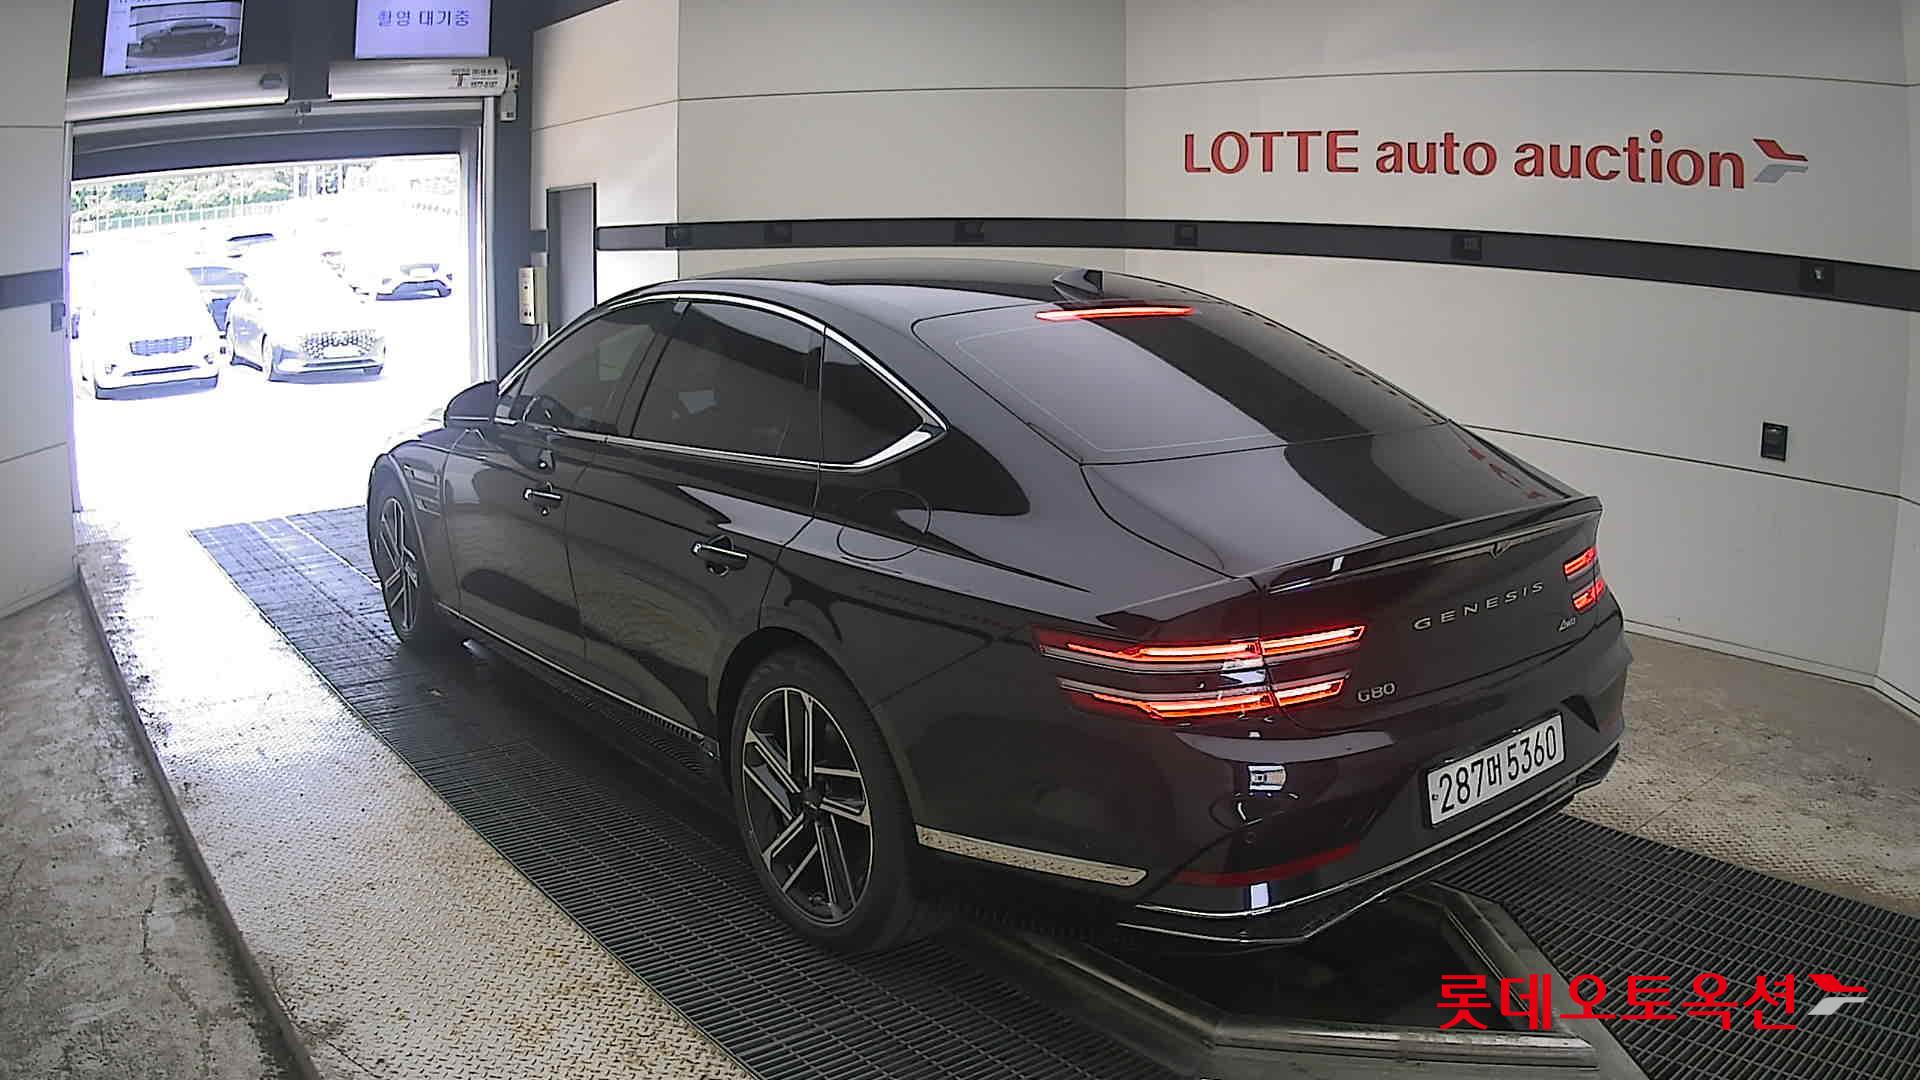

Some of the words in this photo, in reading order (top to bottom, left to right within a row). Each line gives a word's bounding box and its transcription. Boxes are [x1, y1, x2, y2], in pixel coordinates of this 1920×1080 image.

[419, 9, 469, 26] 대기중
[1184, 129, 1359, 174] LOTTE
[1375, 132, 1497, 176] auto
[1513, 129, 1745, 189] auction
[1413, 580, 1544, 631] GENESIS
[1358, 682, 1396, 702] G80
